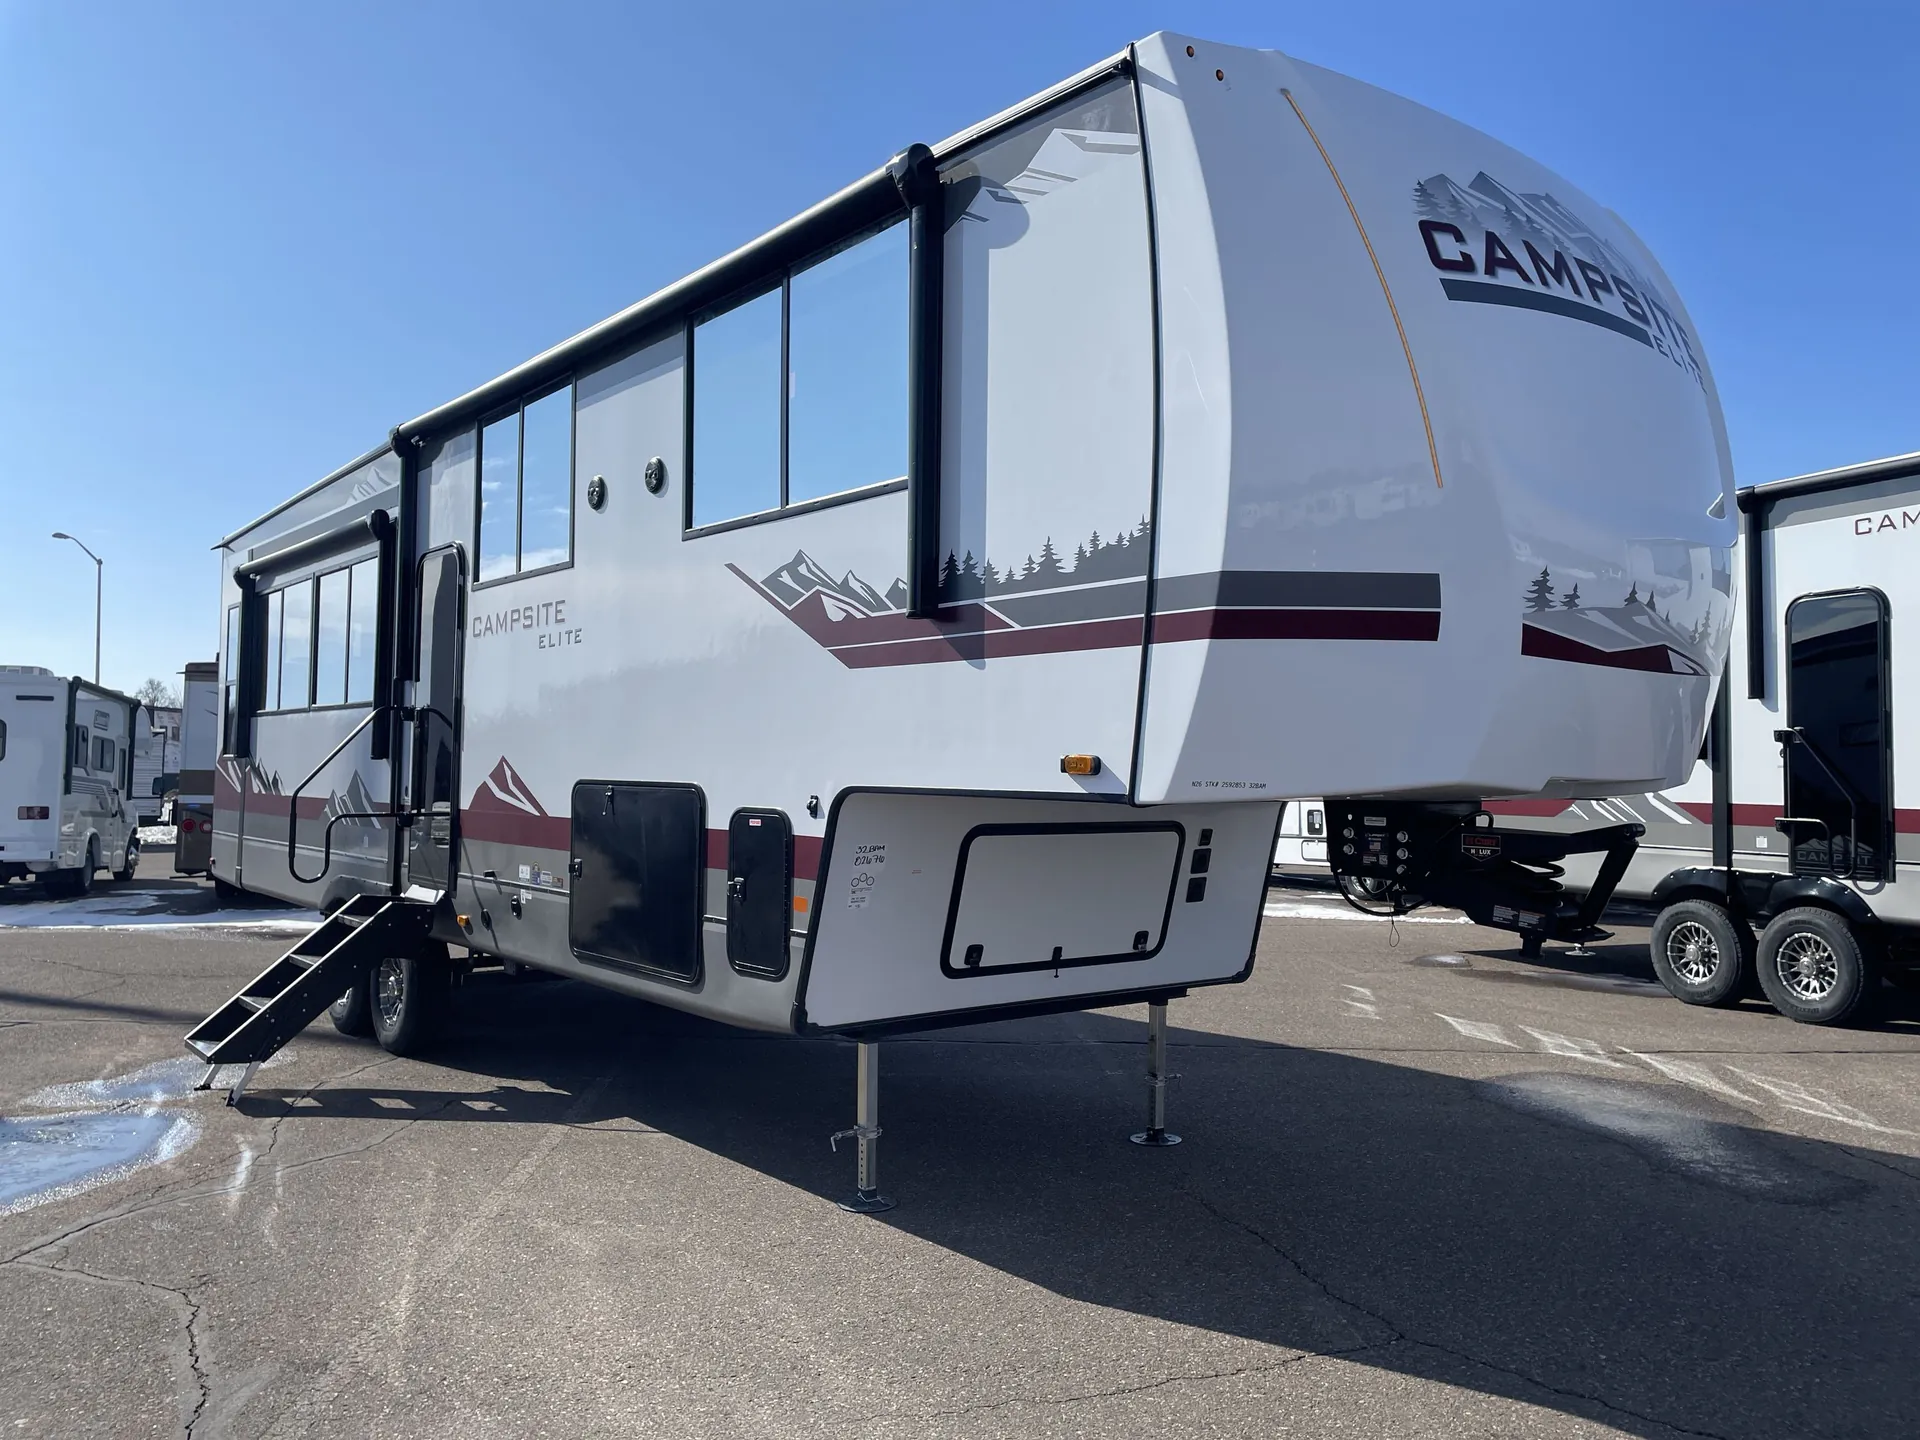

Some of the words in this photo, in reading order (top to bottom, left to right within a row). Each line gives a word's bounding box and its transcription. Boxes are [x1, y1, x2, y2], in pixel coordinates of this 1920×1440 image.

[1418, 219, 1702, 373] CAMPSITE
[1653, 334, 1708, 396] ELITE
[472, 599, 566, 638] CAMPSITE
[538, 627, 582, 650] ELITE
[1797, 850, 1874, 866] CAMPIT
